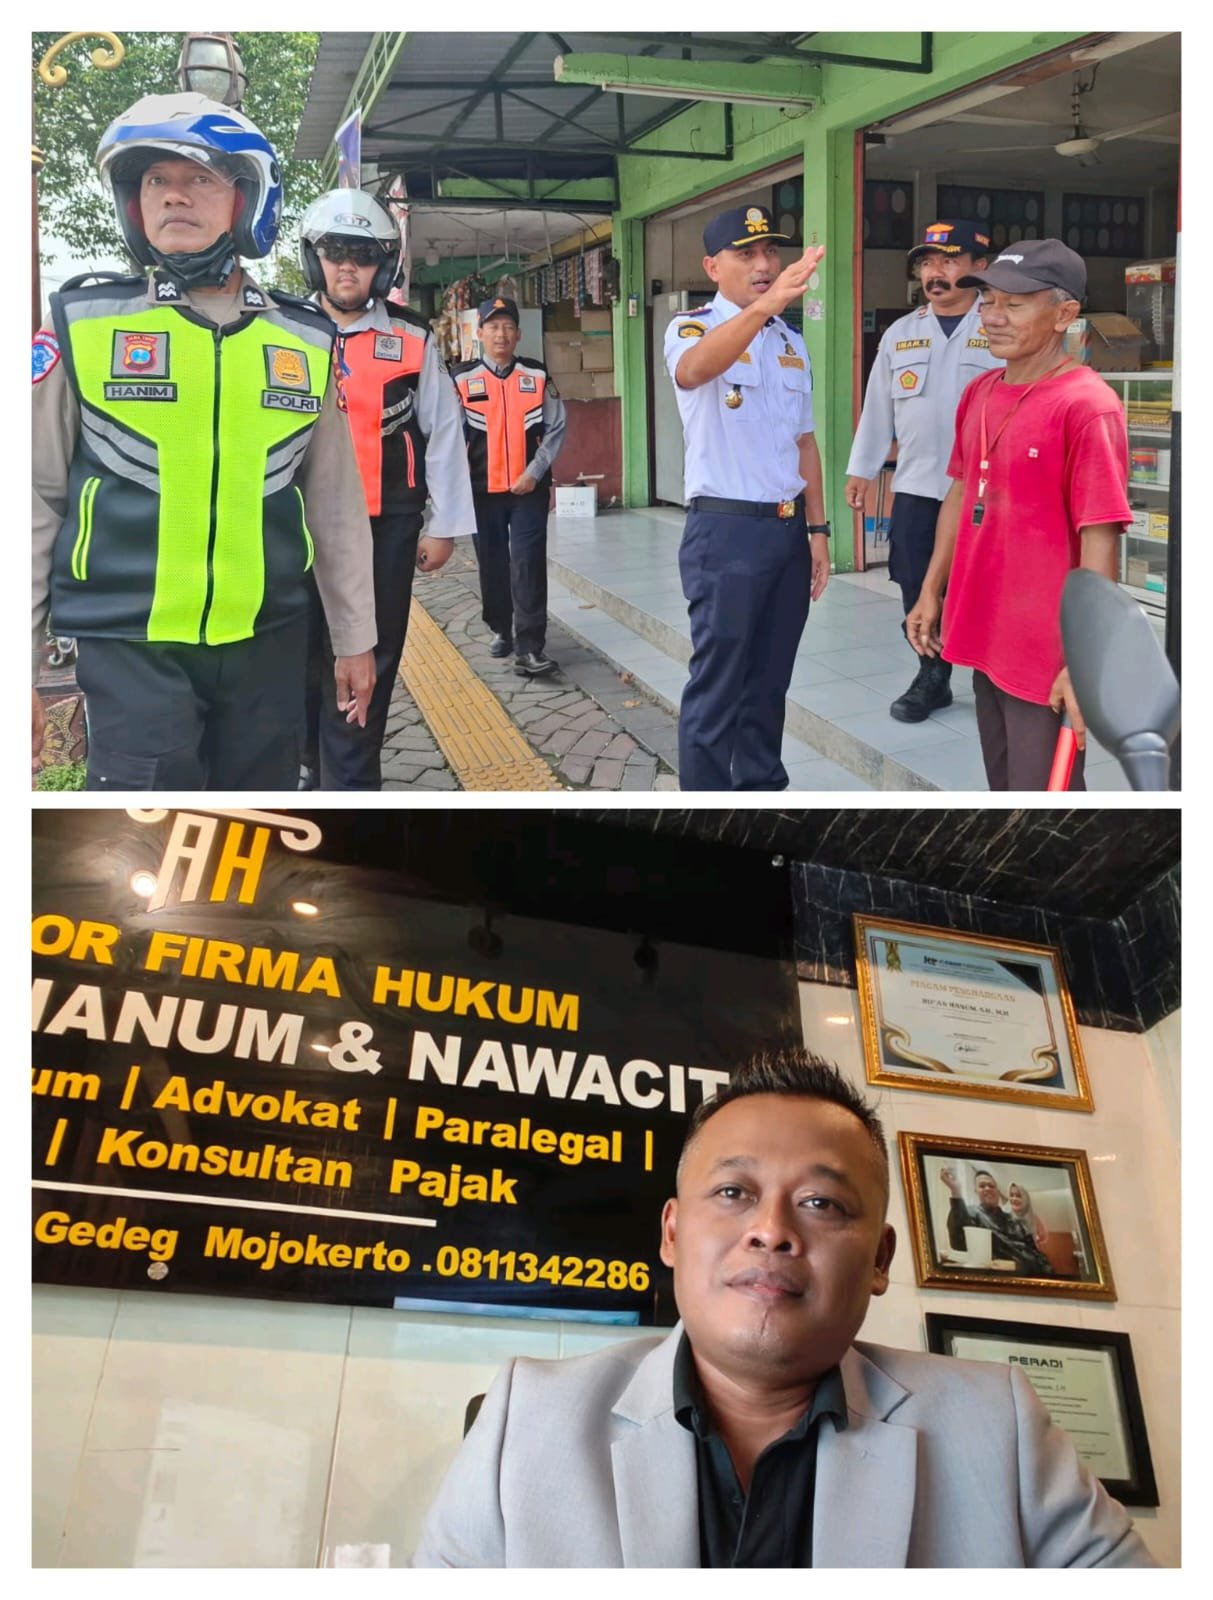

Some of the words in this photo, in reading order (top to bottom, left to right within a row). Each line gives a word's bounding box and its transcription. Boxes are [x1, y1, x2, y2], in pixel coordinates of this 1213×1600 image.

[111, 386, 169, 396] HANIM
[266, 394, 315, 410] POLRI
[144, 930, 342, 998] FIRMA
[372, 965, 580, 1031] HUKUM
[327, 1020, 382, 1075] &
[408, 1030, 731, 1113] NAWACIT
[152, 1075, 362, 1131] Advokat
[414, 1106, 623, 1166] Paralegal
[96, 1127, 353, 1188] Konsultan
[389, 1159, 519, 1207] Pajak
[34, 1210, 179, 1262] Gedeg
[203, 1225, 411, 1273] Mojokerto
[1008, 1355, 1064, 1369] PERADI
